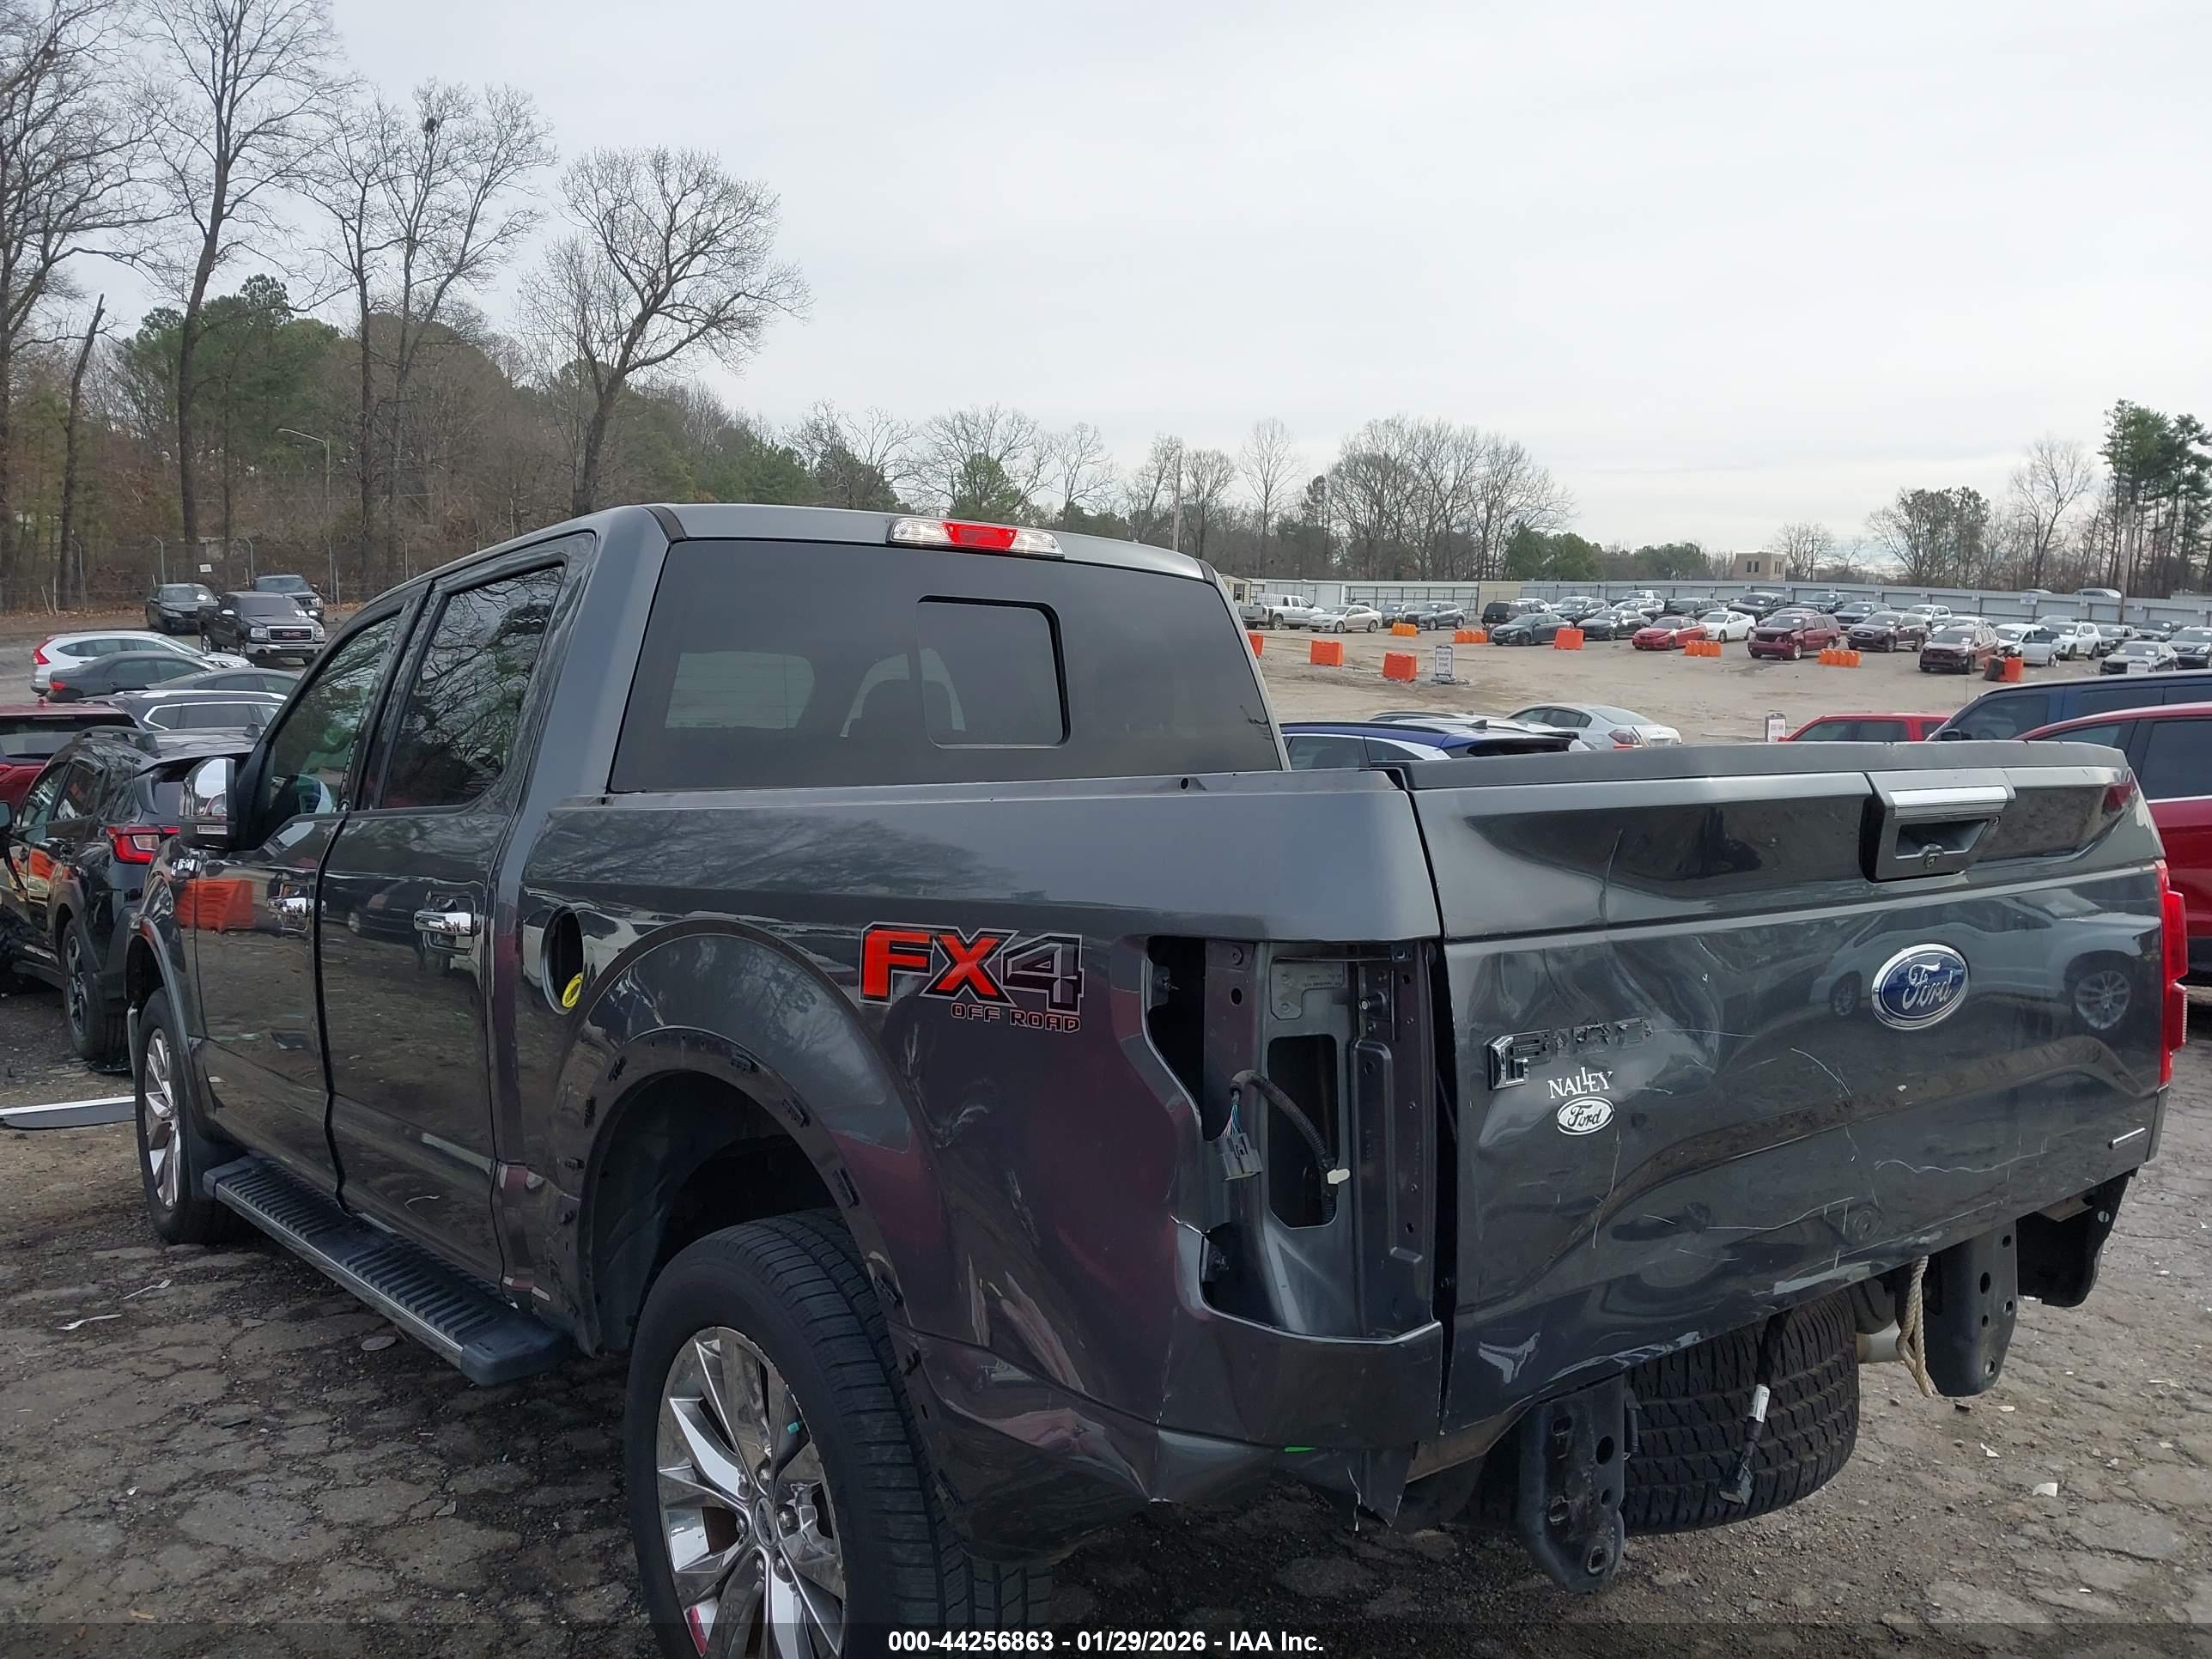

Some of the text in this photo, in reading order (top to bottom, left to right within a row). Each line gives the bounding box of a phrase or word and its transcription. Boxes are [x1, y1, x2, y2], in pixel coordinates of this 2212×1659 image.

[859, 921, 1085, 1016] FX4
[1902, 962, 1954, 1010] Ford
[951, 1002, 1081, 1033] OFF ROAD
[1547, 1066, 1613, 1099] NALLEY
[1567, 1104, 1602, 1127] Ford
